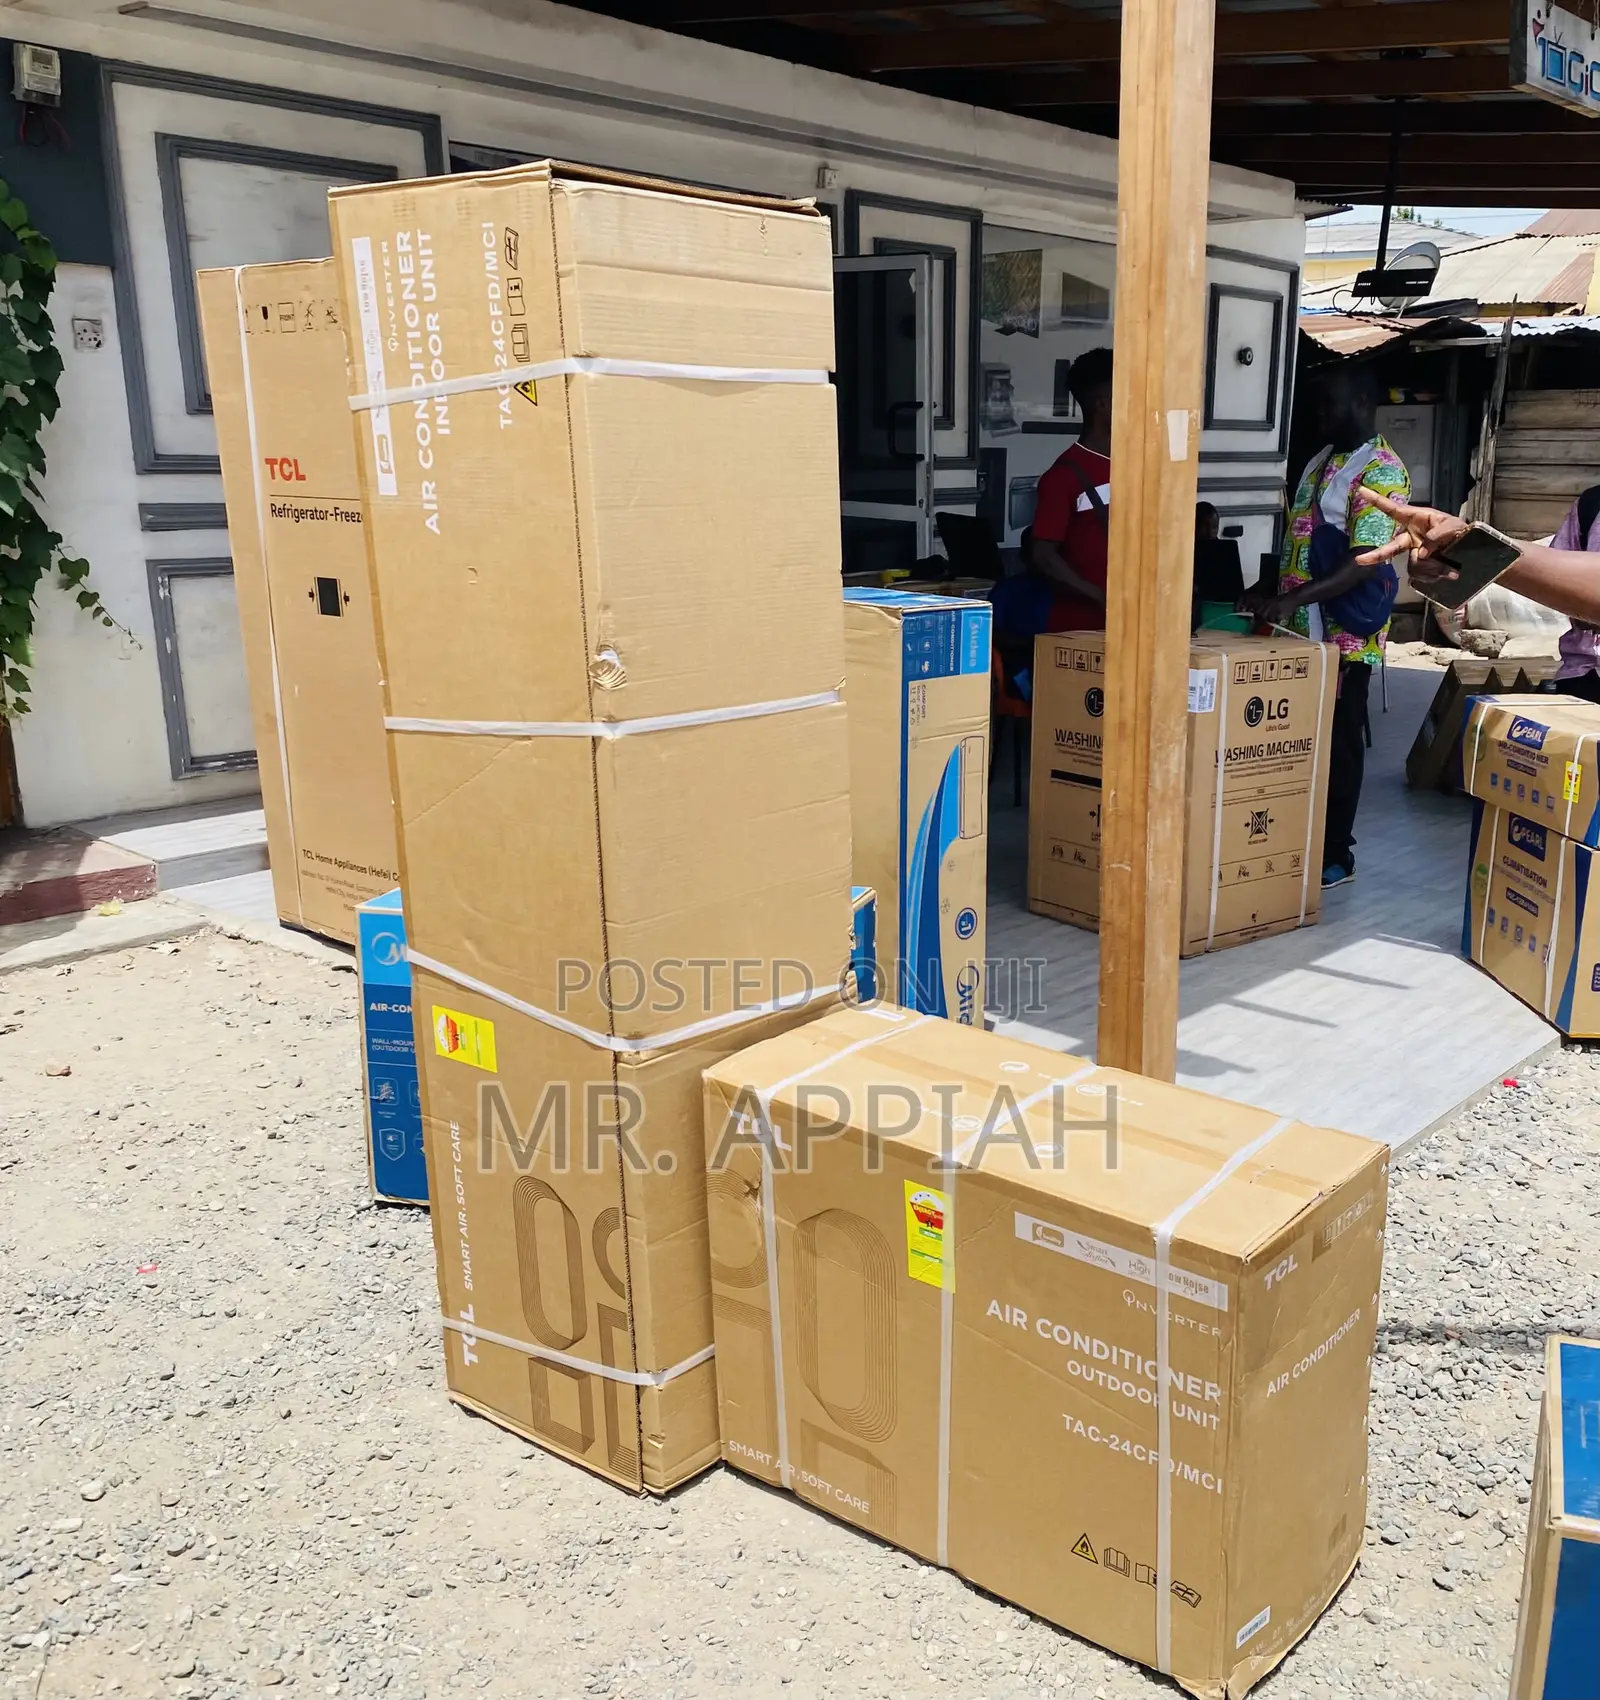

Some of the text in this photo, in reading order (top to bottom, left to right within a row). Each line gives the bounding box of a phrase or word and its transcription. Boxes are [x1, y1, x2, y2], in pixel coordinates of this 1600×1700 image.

[418, 229, 435, 303] UNIT
[396, 231, 441, 535] AIR CONDITIONER
[265, 457, 306, 481] TCL
[270, 503, 363, 523] Refrigerator-Freez
[1267, 698, 1289, 720] LG
[1054, 728, 1104, 749] WASHIN
[1266, 738, 1312, 756] MACHINE
[302, 849, 314, 860] TCL
[315, 855, 333, 865] Home
[334, 858, 367, 875] Appliances
[449, 1120, 462, 1163] CARE
[453, 1165, 465, 1206] SOFT
[460, 1239, 473, 1291] SMART
[1168, 1273, 1182, 1285] ow
[1264, 1253, 1298, 1291] TCL
[986, 1299, 1221, 1406] AIR CONDITIONER
[1266, 1307, 1361, 1398] AIR CONDITIONER
[1172, 1400, 1221, 1431] UNIT
[729, 1440, 772, 1466] SMART
[801, 1471, 832, 1494] SOFT
[835, 1489, 870, 1513] CARE
